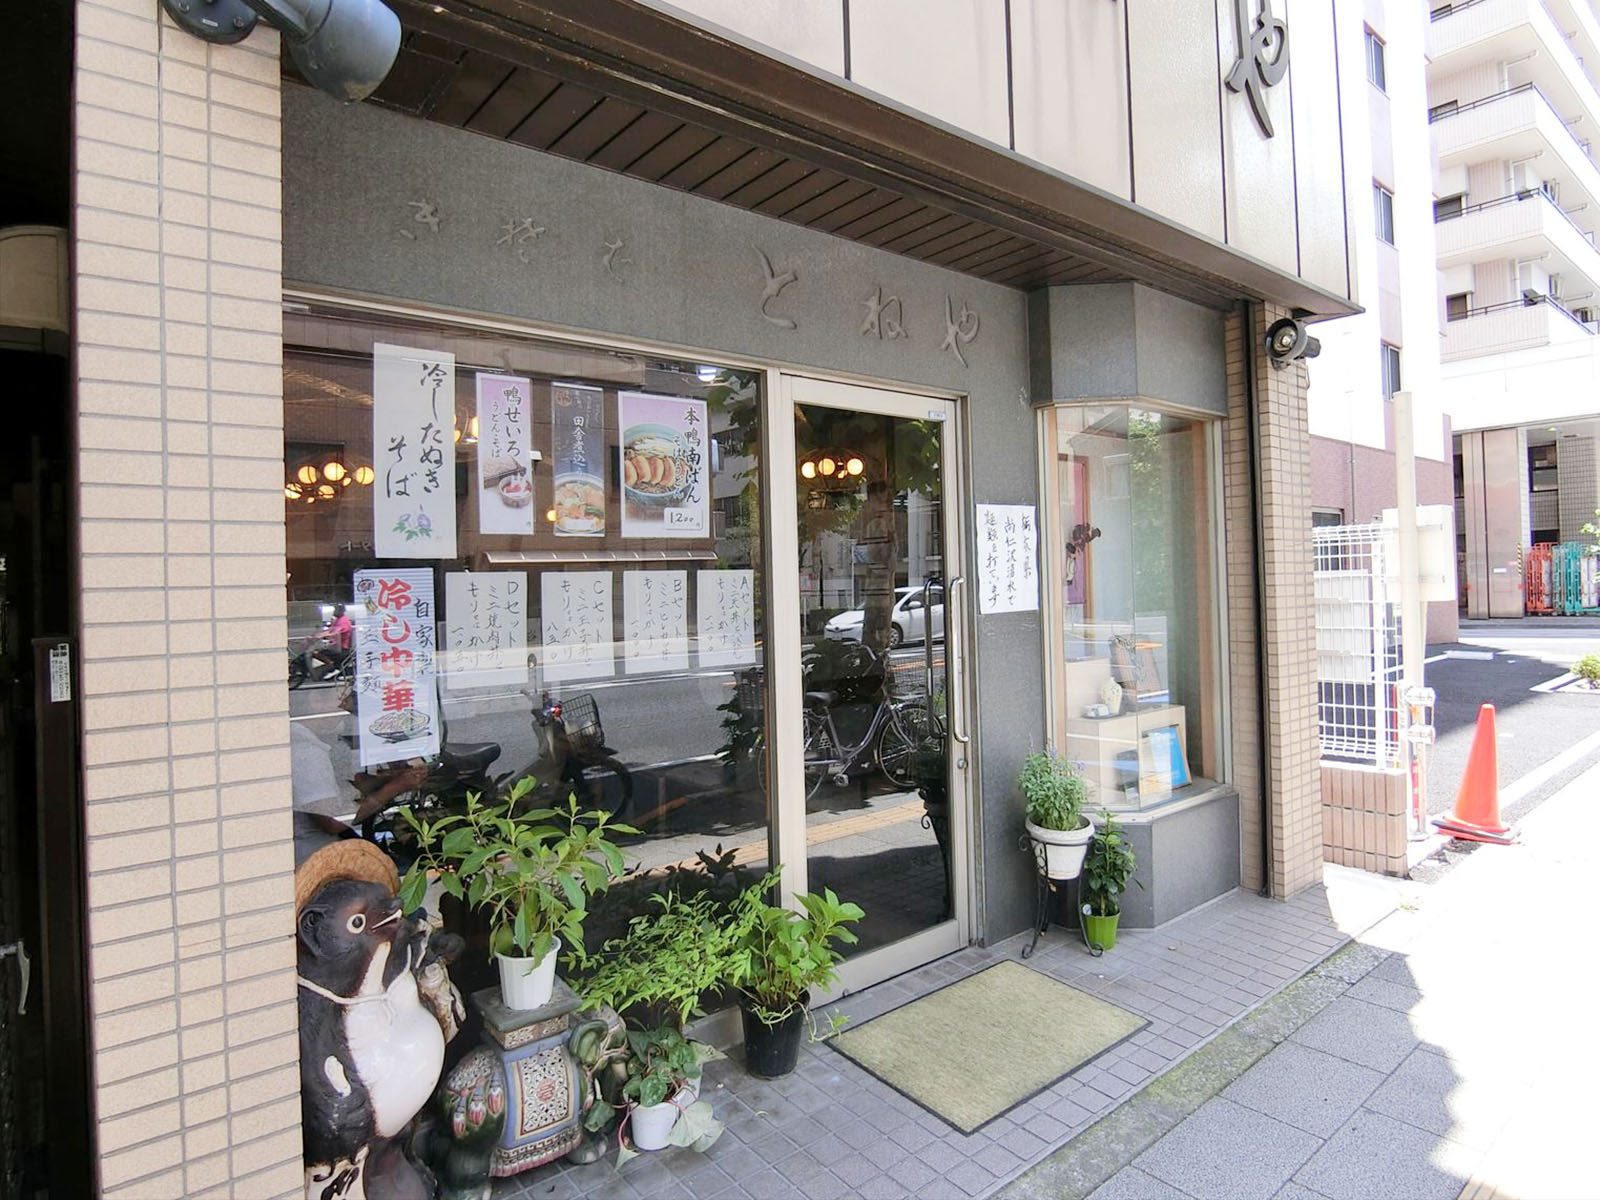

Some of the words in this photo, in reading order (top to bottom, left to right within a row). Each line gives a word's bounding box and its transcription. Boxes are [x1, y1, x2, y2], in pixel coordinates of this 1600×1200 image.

[751, 242, 981, 368] とねや
[419, 362, 447, 493] 冷したぬき
[503, 386, 521, 458] 鴨せいろ
[684, 407, 702, 503] 本鴨南ばん
[386, 435, 418, 498] そば
[504, 581, 520, 648] Dセット
[592, 580, 604, 643] Cセット
[672, 579, 683, 638] Bセット
[740, 576, 750, 631] Aセット
[377, 578, 415, 711] 冷し中華
